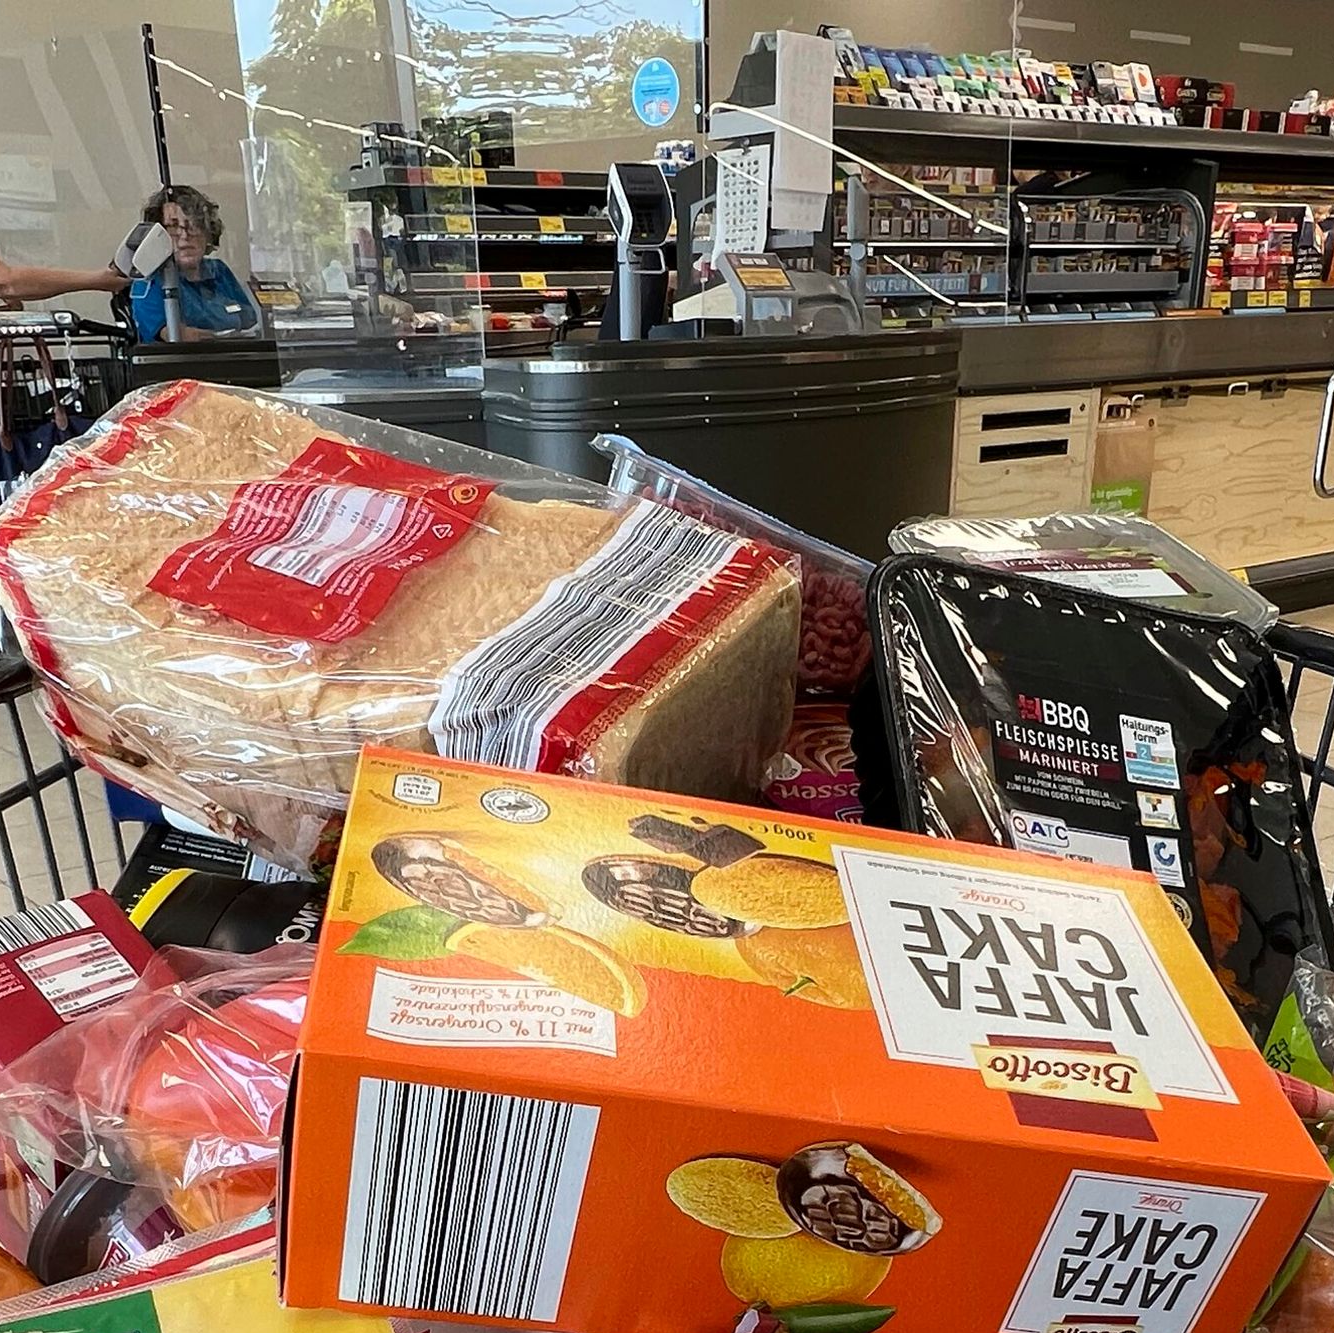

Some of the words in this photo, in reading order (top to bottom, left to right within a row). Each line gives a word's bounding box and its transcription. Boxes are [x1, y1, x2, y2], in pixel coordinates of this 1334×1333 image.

[1042, 699, 1091, 735] BBQ
[1121, 717, 1170, 736] Haltungs-
[995, 720, 1120, 763] FLEISCHSPIESSE
[1133, 730, 1158, 744] form
[1019, 748, 1100, 777] MARINIERT
[773, 782, 862, 799] essert
[889, 900, 1129, 985] CAKE
[908, 955, 1150, 1037] JAFFA
[389, 1010, 503, 1034] Orangensaft
[509, 1020, 530, 1037] %
[987, 1050, 1139, 1096] Biscotto
[1063, 1209, 1220, 1271] CAKE
[1052, 1256, 1198, 1312] JAFFA
